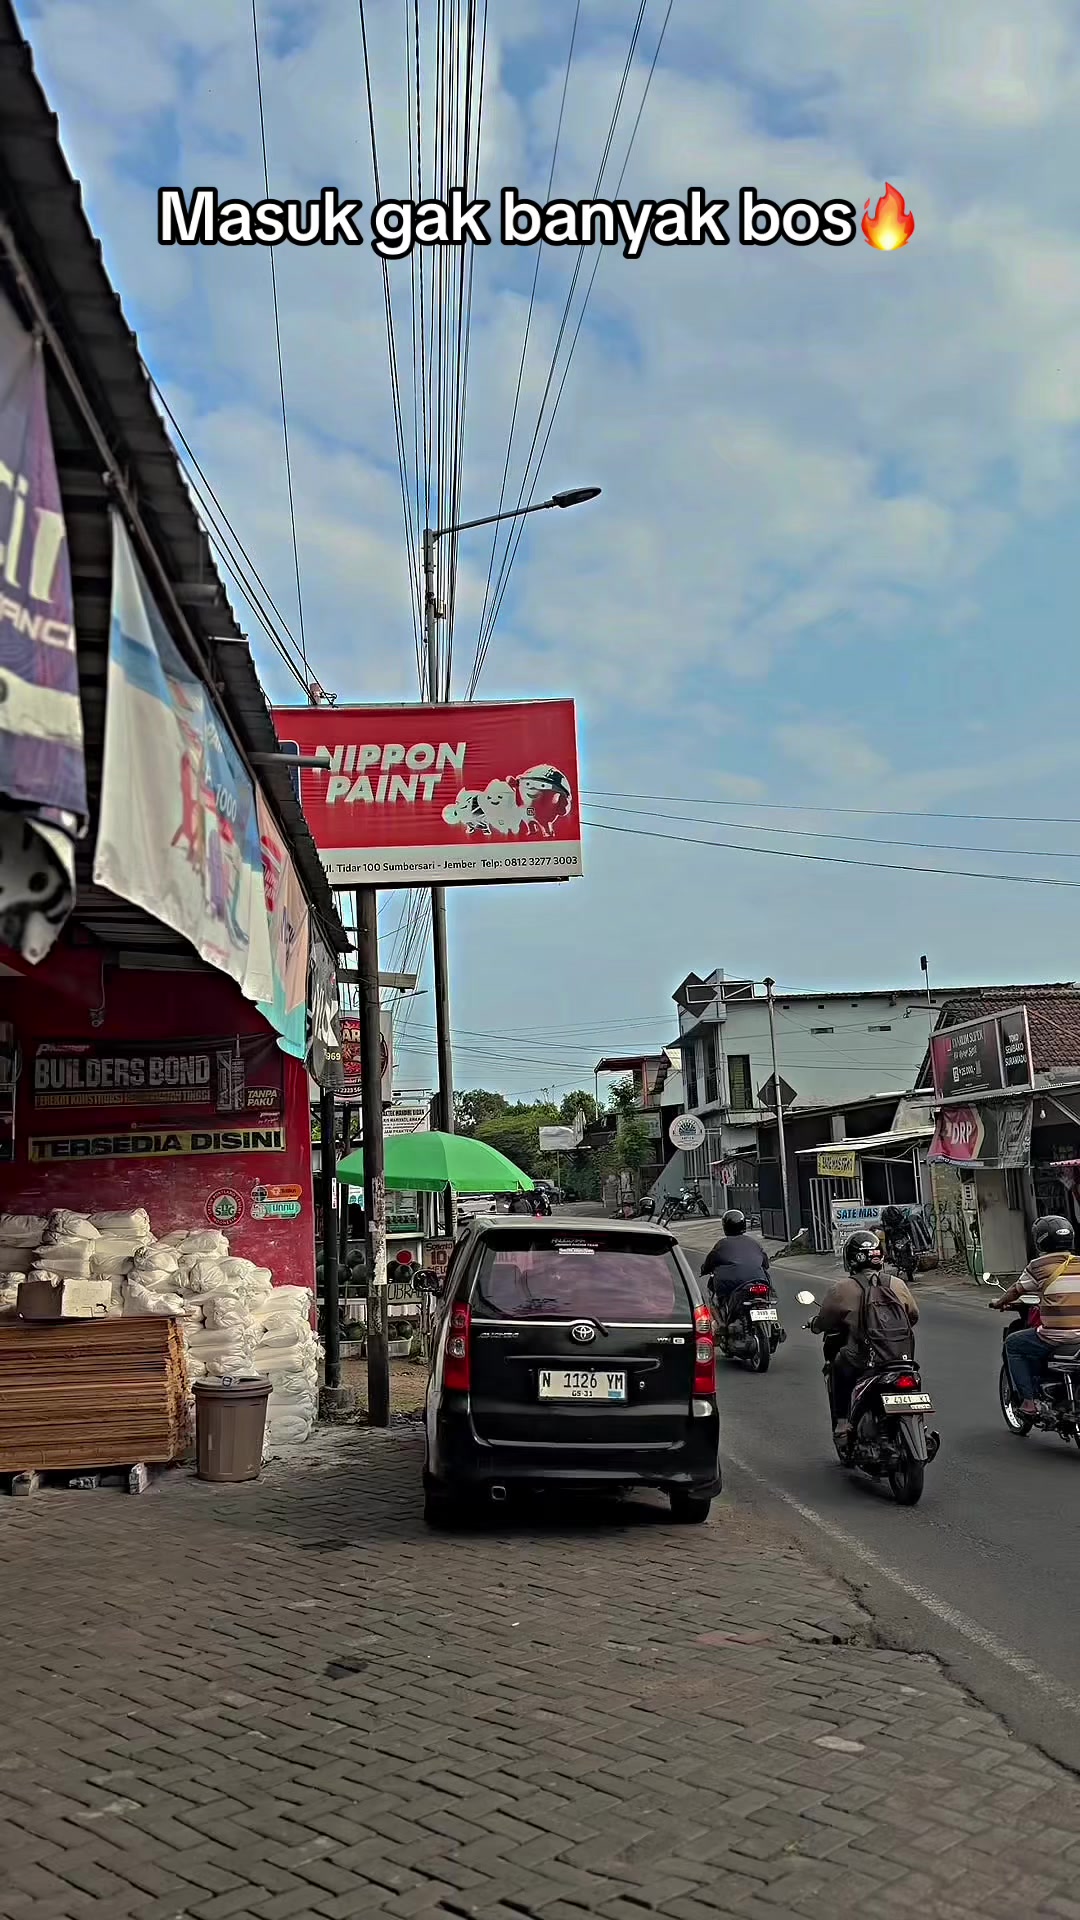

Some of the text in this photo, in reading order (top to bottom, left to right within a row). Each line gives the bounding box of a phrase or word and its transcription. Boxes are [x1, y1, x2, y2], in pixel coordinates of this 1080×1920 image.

[312, 742, 467, 773] NIPPON
[325, 773, 443, 803] PAINT
[336, 863, 361, 873] Tidar
[363, 863, 381, 872] 100
[383, 861, 435, 872] Sumbersari
[443, 860, 477, 869] Jember
[481, 859, 503, 869] Telp:
[504, 858, 527, 867] 0812
[529, 857, 552, 866] 3277
[553, 856, 578, 866] 3003
[35, 1058, 145, 1089] BUILDERS
[149, 1055, 210, 1086] BOND
[247, 1089, 278, 1098] TANPA
[247, 1098, 274, 1107] PAKU
[950, 1121, 973, 1145] DRP
[32, 1135, 182, 1159] TERSEDIA
[836, 1208, 879, 1220] SATE MAS
[542, 1373, 624, 1390] N 1126 YM
